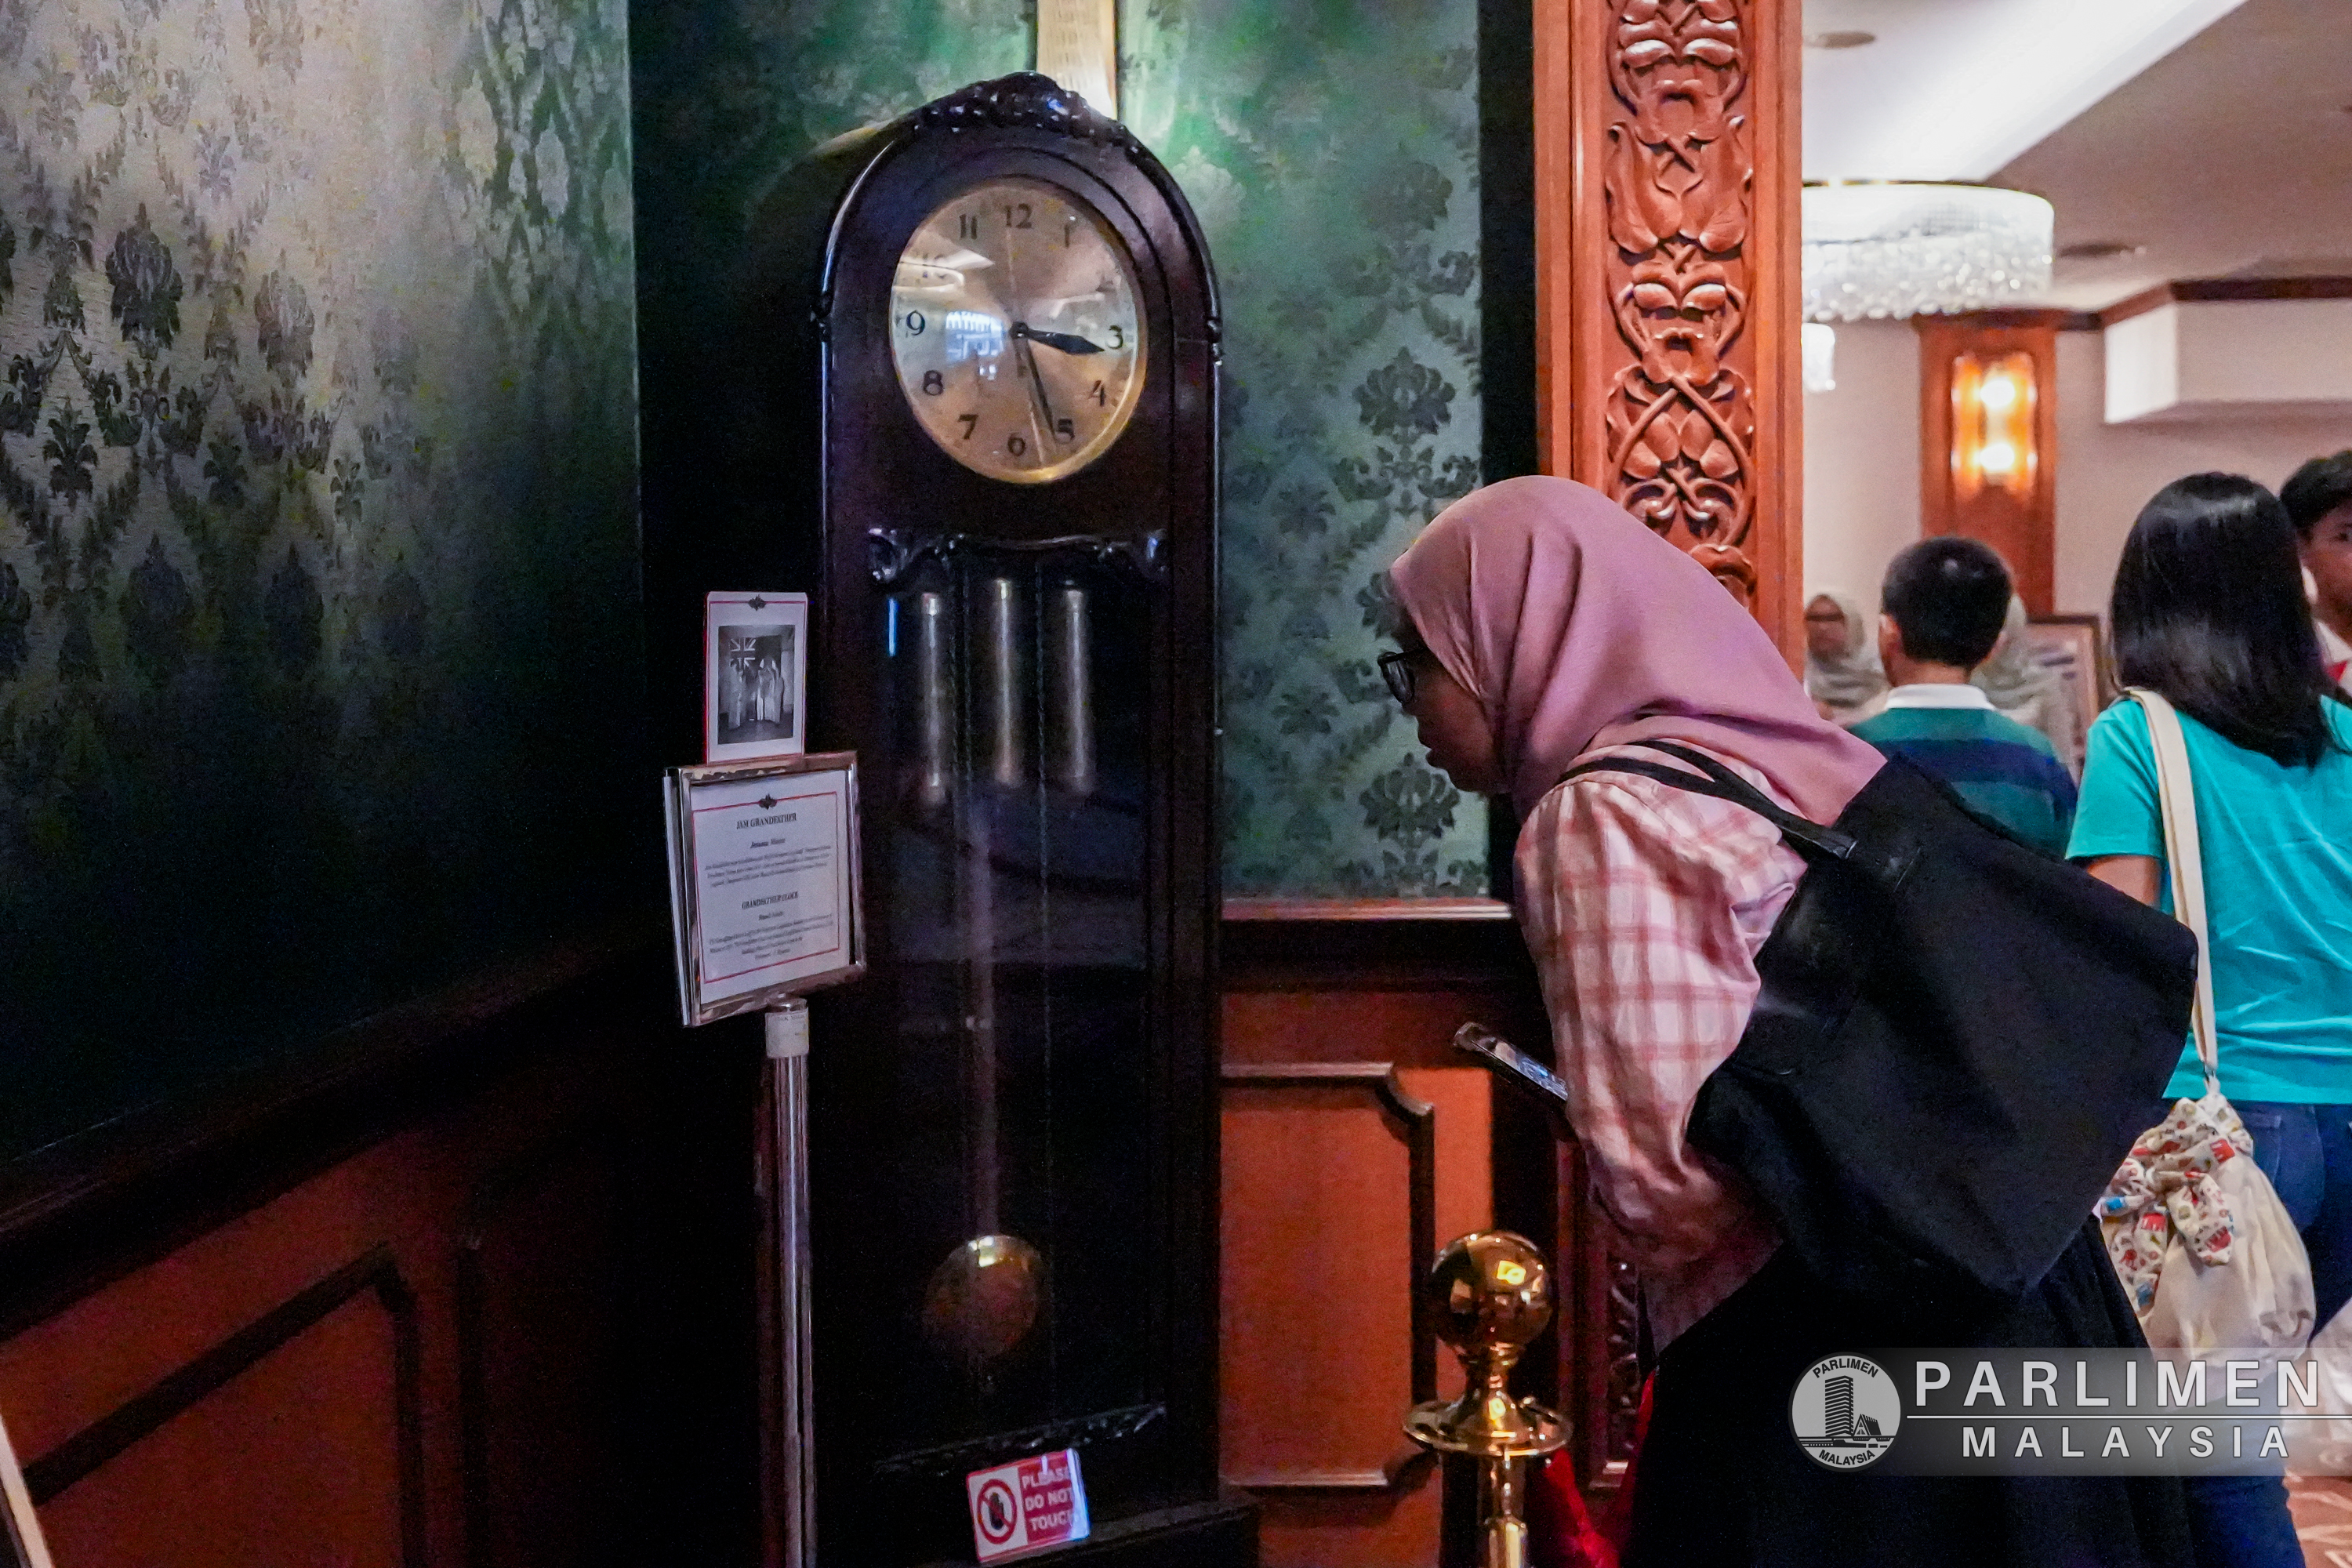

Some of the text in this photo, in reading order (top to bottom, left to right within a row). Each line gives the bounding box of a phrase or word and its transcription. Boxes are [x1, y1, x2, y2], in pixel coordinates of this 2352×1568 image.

[959, 213, 978, 240] 11
[1005, 203, 1033, 229] 12
[1063, 223, 1071, 248] 1
[906, 310, 926, 336] 9
[1107, 325, 1124, 350] 3
[922, 369, 944, 396] 8
[1089, 379, 1106, 407] 4
[957, 414, 979, 440] 7
[1054, 418, 1075, 444] 5
[1007, 432, 1026, 457] 6
[1025, 1494, 1044, 1511] DO
